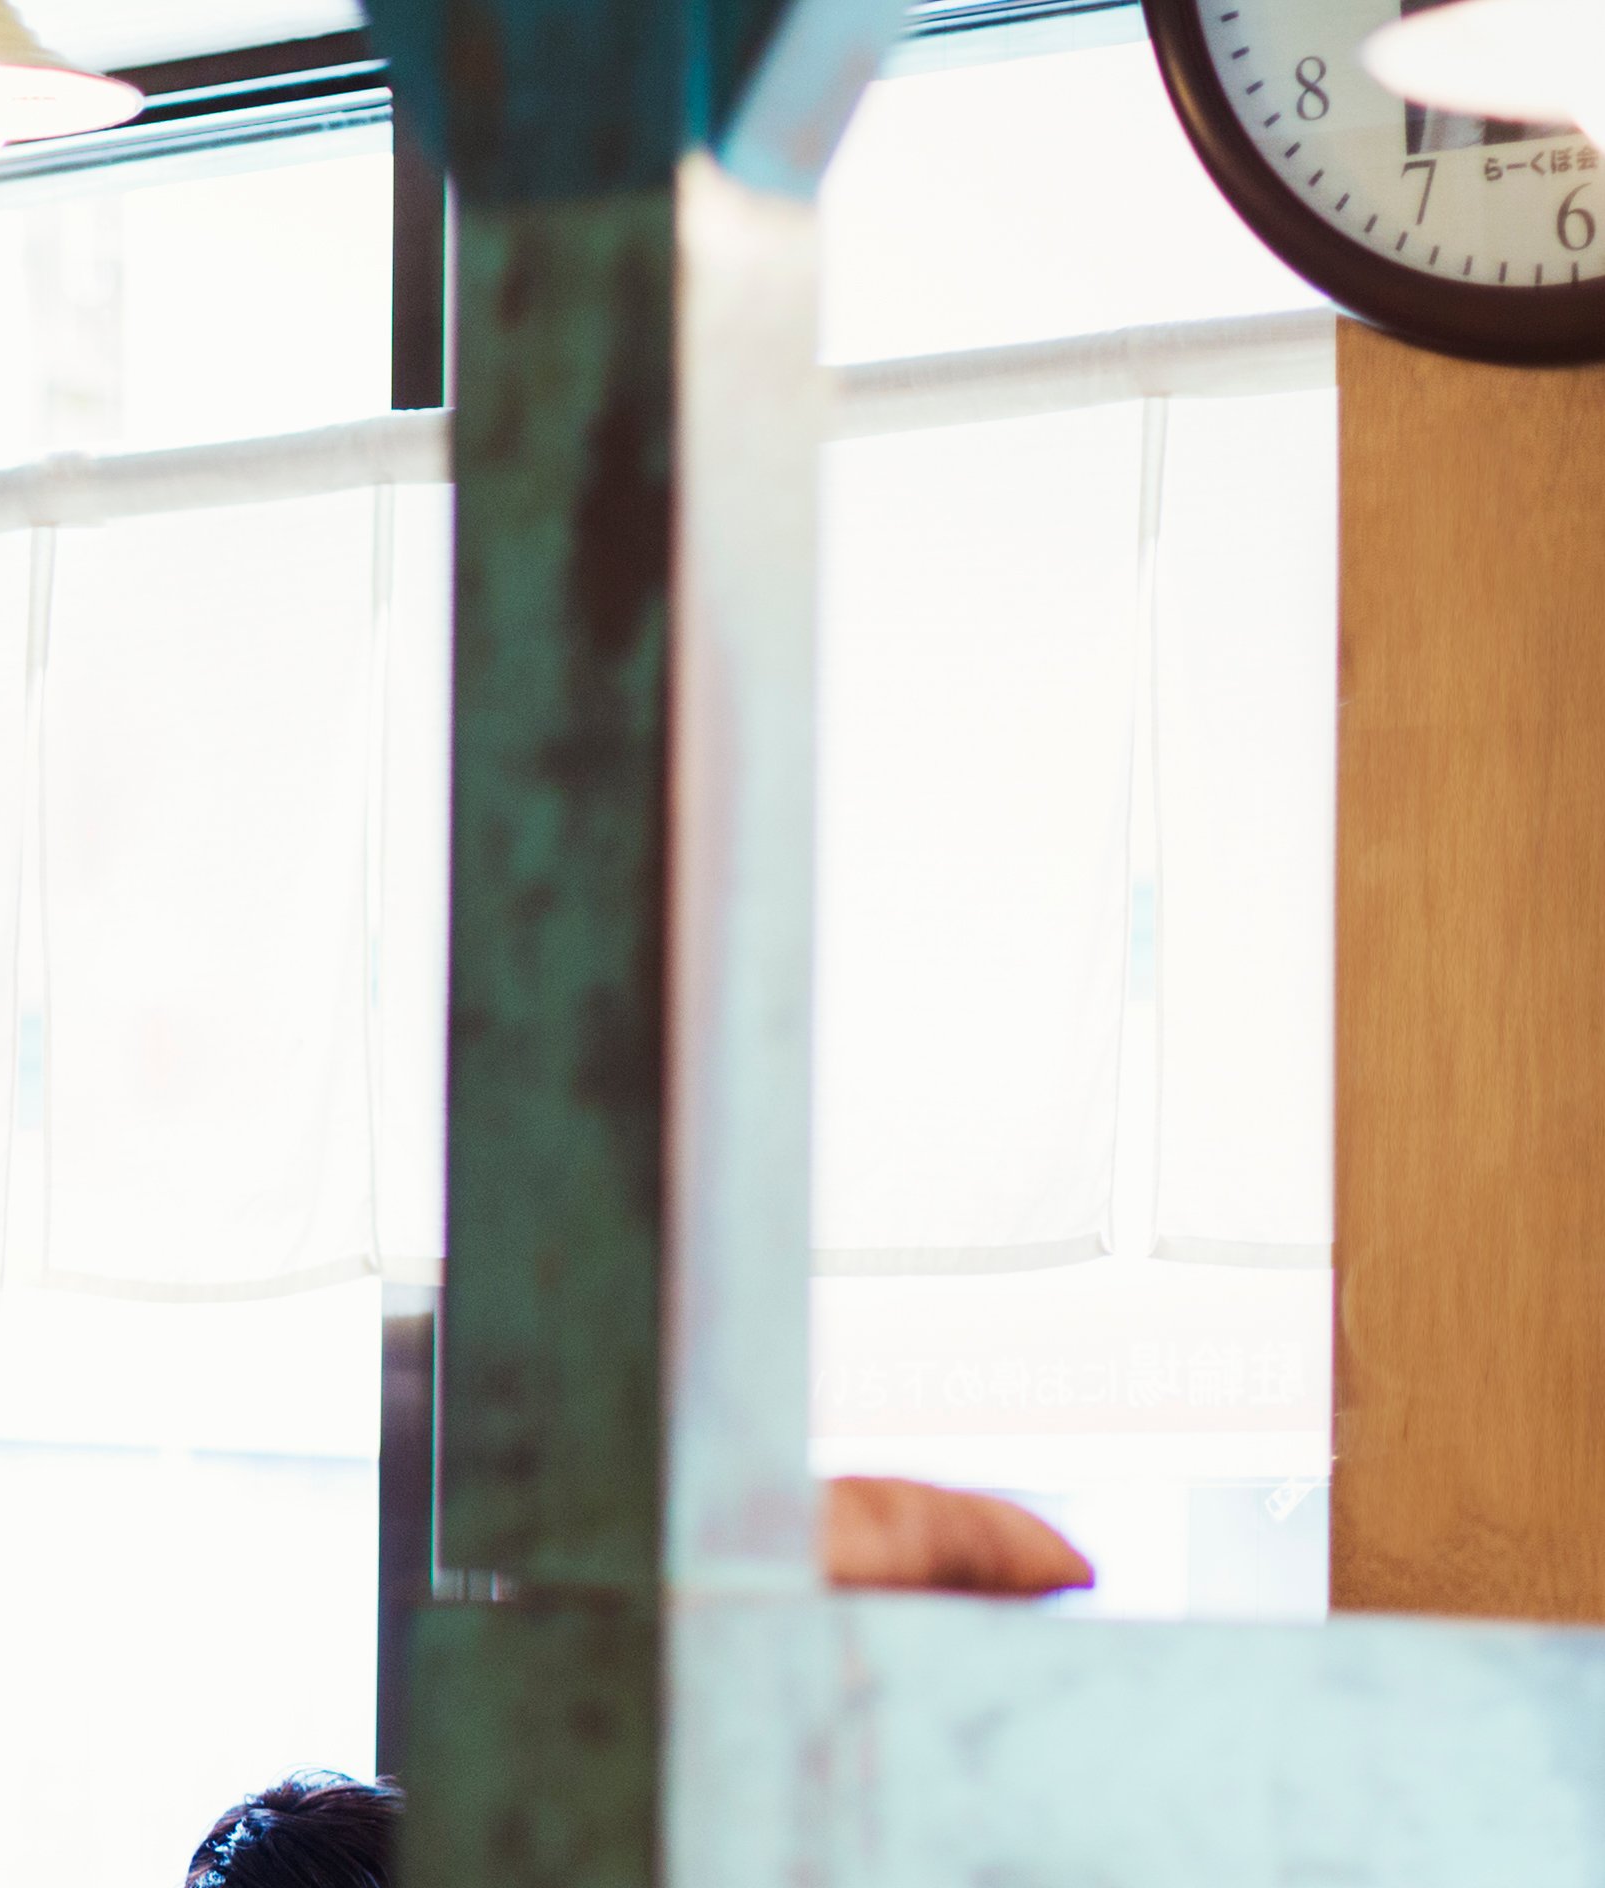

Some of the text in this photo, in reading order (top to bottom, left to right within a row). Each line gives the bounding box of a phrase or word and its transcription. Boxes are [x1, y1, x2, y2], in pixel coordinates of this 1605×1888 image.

[1294, 56, 1330, 121] 8
[1400, 158, 1437, 225] 7
[1556, 181, 1596, 251] 6
